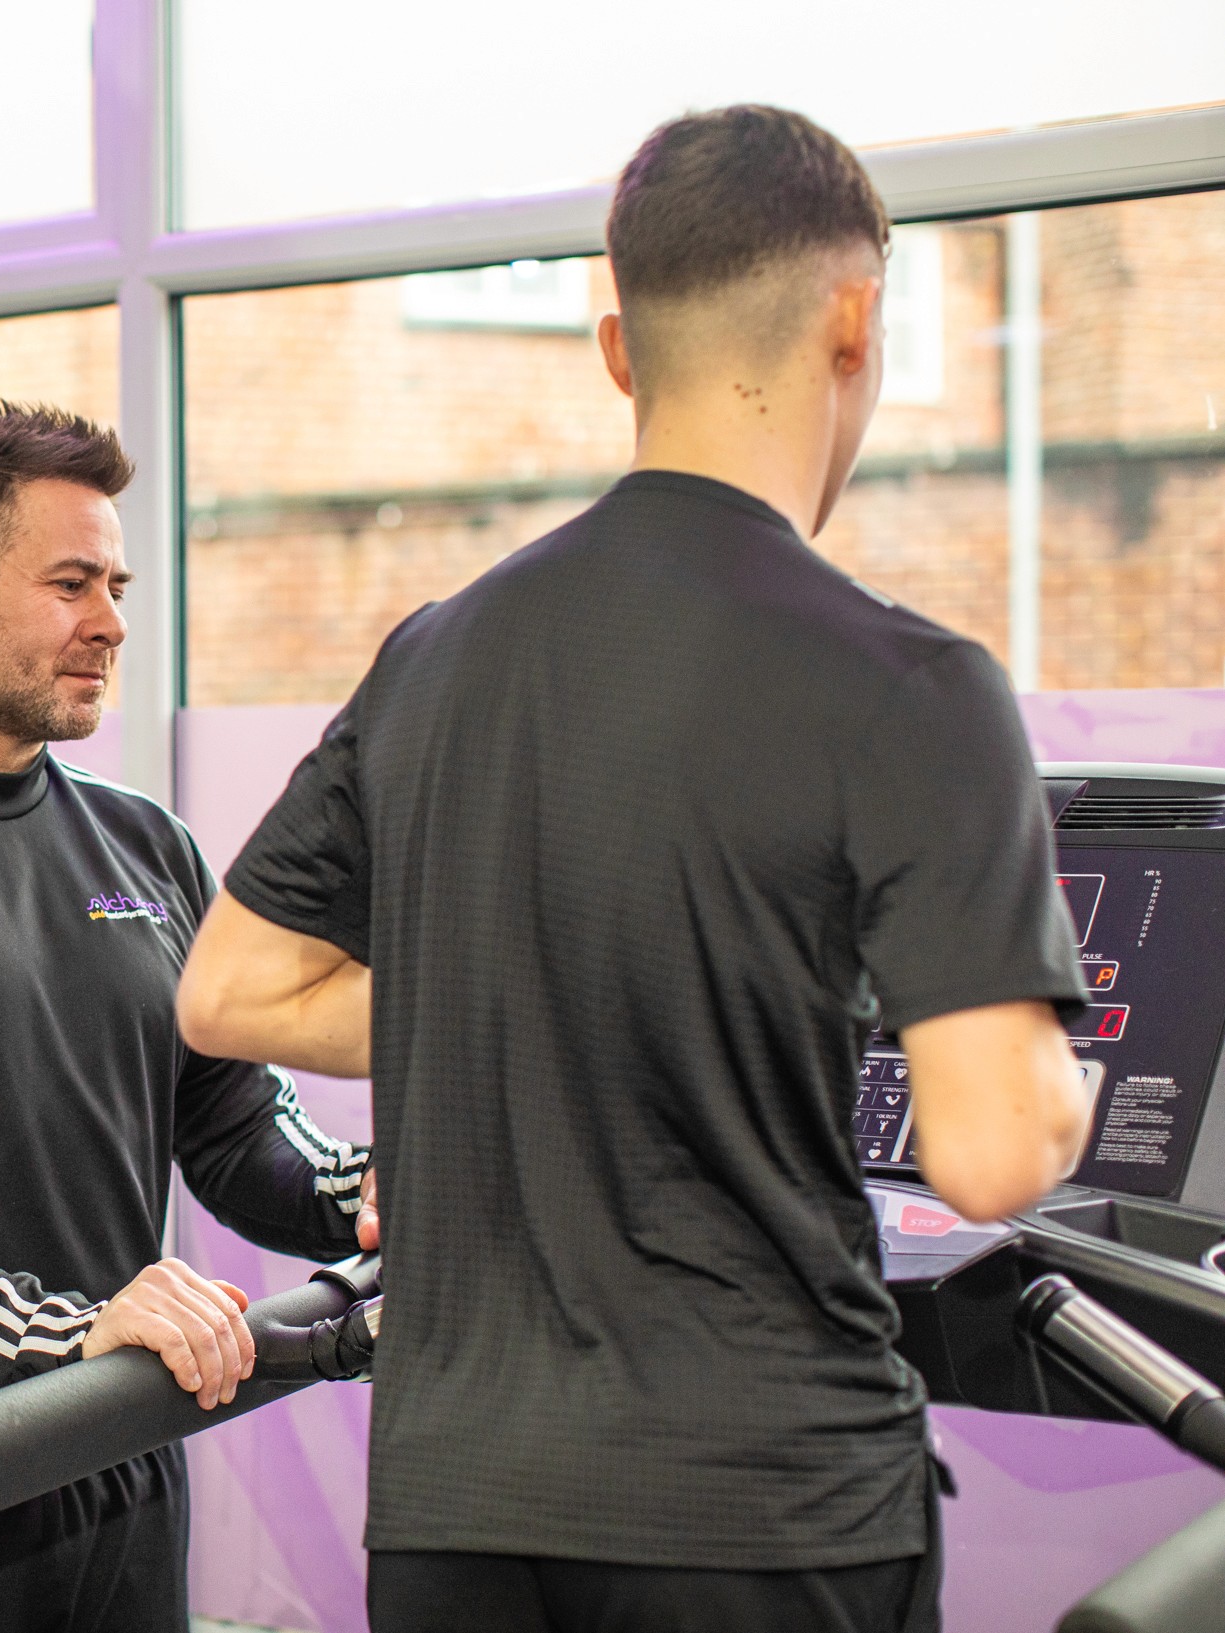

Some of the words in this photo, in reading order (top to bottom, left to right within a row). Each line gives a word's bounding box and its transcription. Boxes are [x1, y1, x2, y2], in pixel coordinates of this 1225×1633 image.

[1096, 968, 1114, 985] P
[1097, 1009, 1126, 1037] 0
[1127, 1076, 1174, 1084] WARNING!
[909, 1218, 944, 1228] STOP
